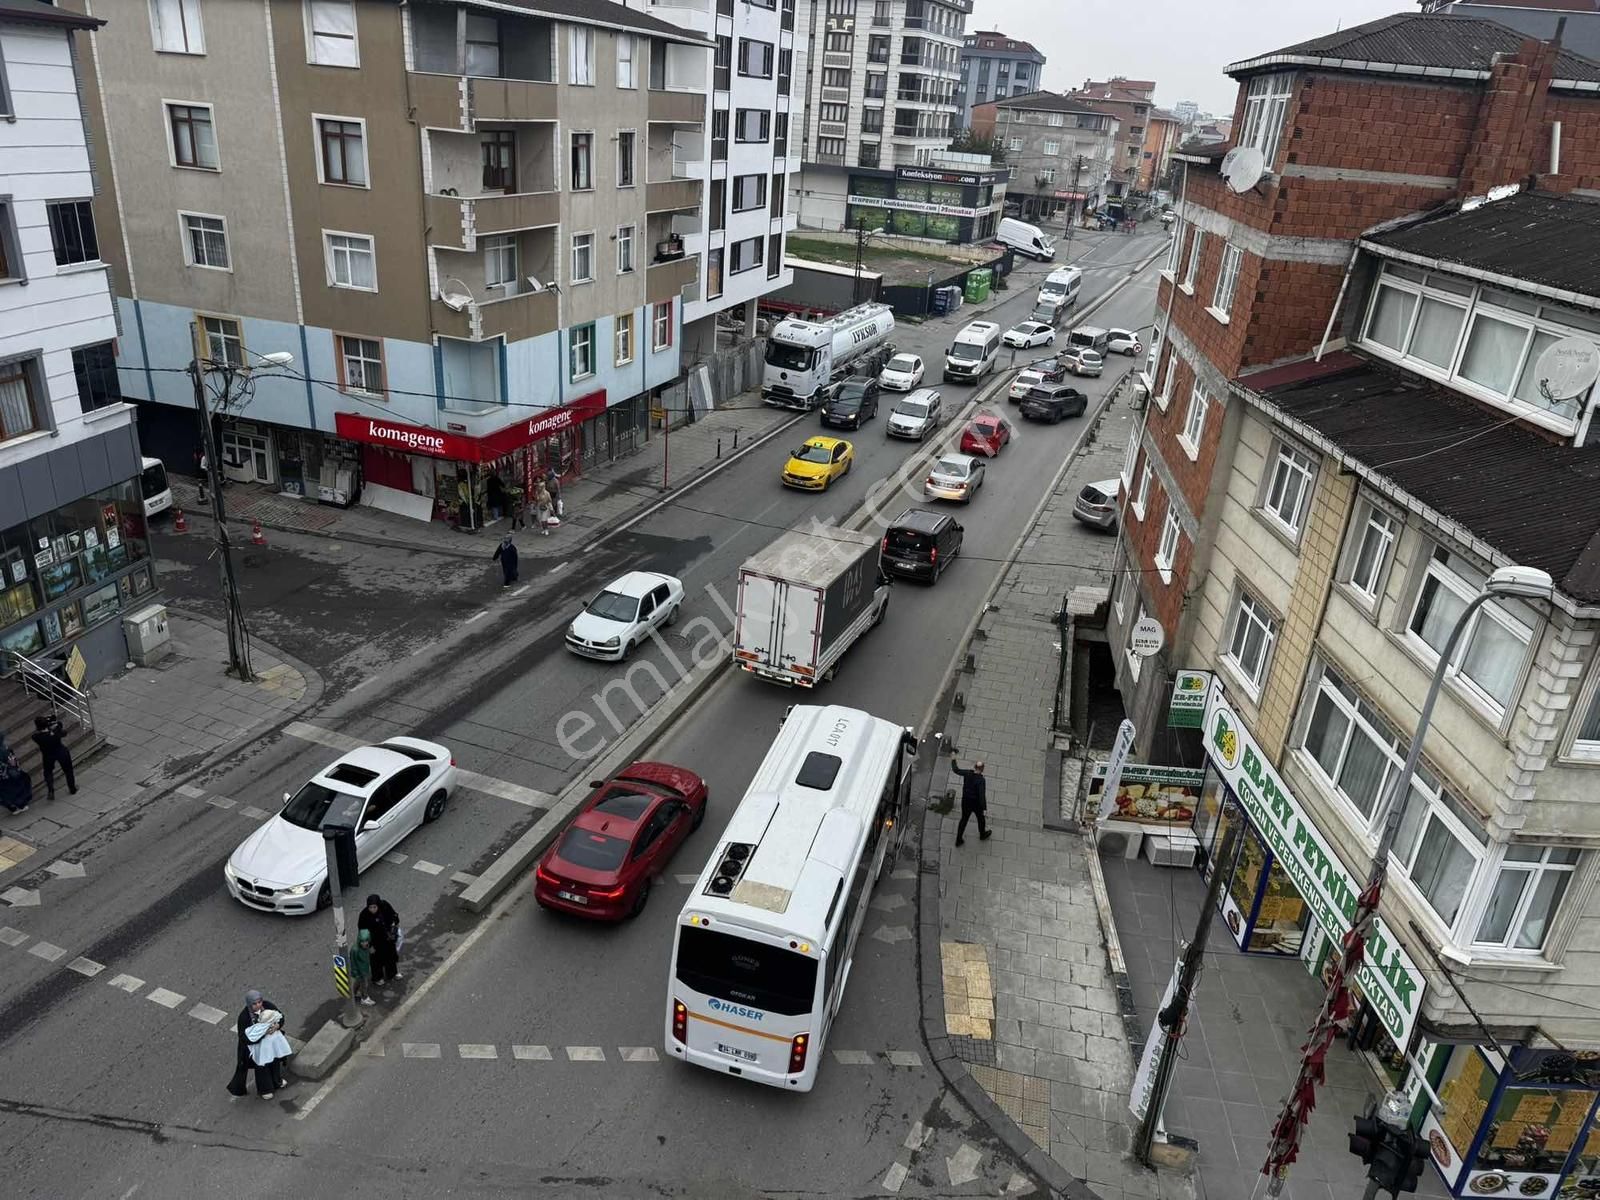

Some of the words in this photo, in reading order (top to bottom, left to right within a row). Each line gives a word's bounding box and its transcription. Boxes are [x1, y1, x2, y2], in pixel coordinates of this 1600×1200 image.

[369, 421, 444, 448] komagene
[528, 410, 572, 436] komagene
[1240, 782, 1267, 830] TOPTAN
[1266, 822, 1279, 846] VE
[1278, 841, 1327, 920] PERAKENDE
[1241, 743, 1295, 830] ER-PEY
[1292, 818, 1417, 1015] PEYNİRİLİK
[721, 1003, 764, 1021] HASER
